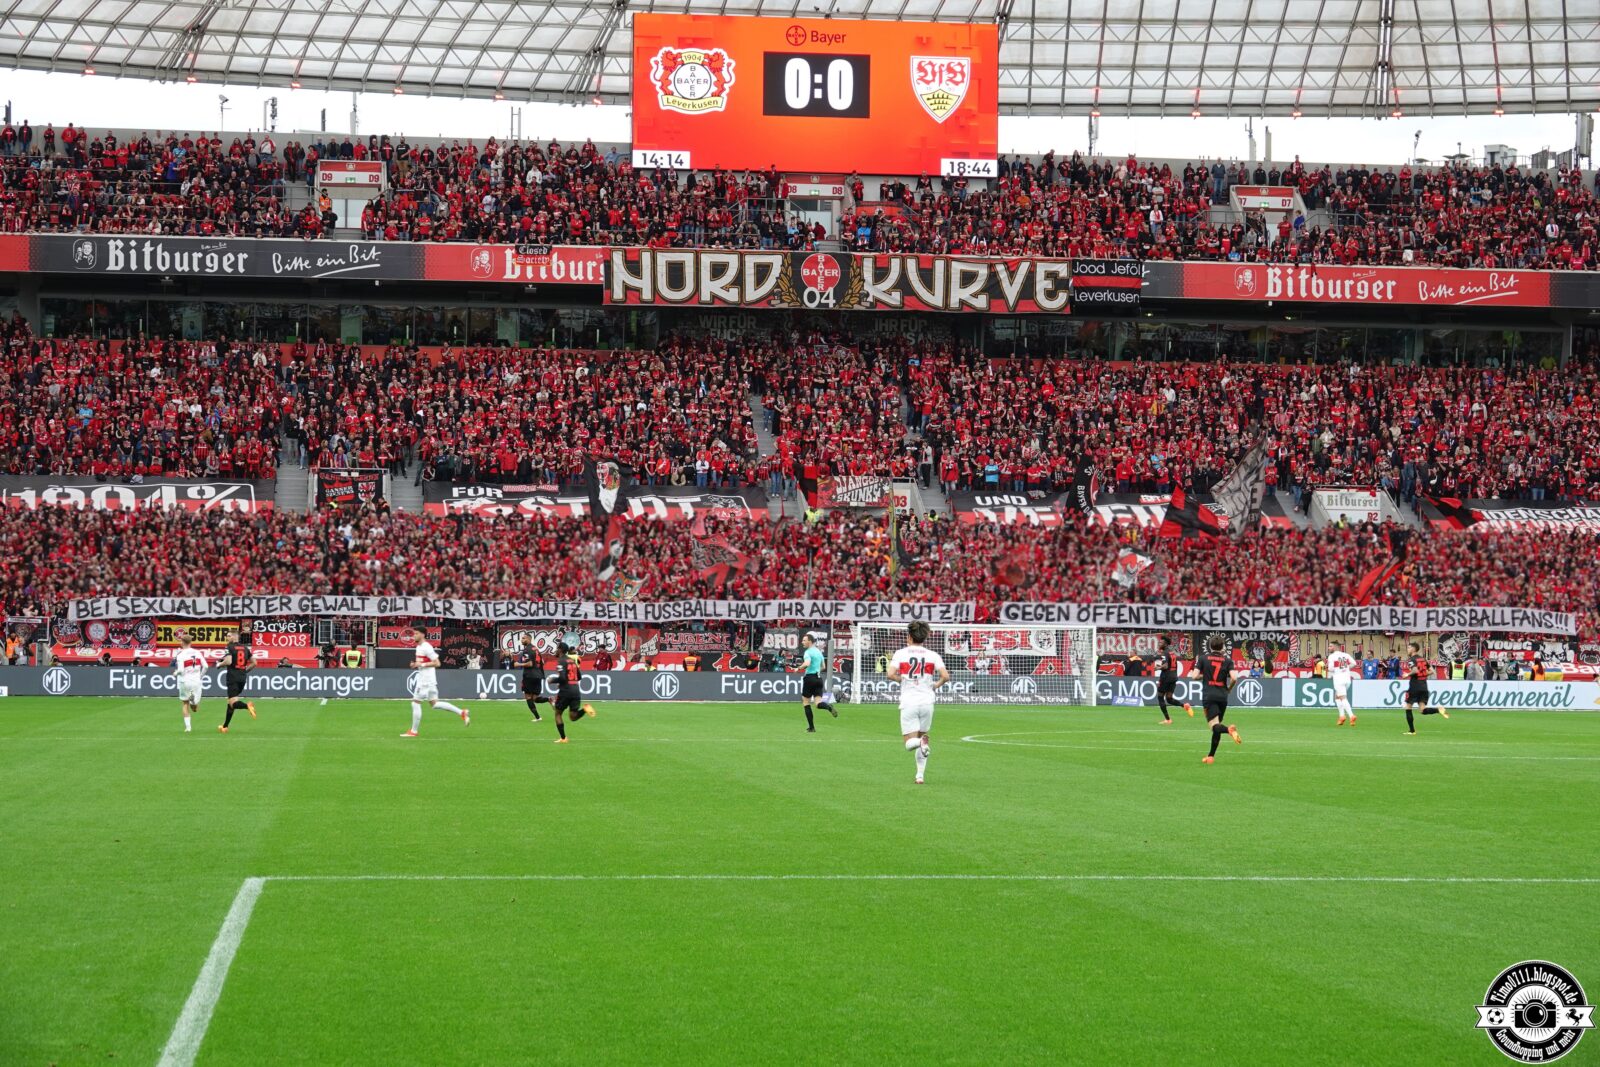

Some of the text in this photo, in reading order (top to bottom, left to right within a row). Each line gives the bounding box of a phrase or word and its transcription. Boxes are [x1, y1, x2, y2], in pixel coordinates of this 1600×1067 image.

[811, 30, 846, 46] Bayer
[683, 54, 702, 62] 1904
[917, 60, 966, 86] VfB
[785, 57, 853, 110] 0:0
[666, 97, 718, 110] Leverkusen
[642, 153, 684, 166] 14:14
[950, 161, 991, 174] 18:44
[322, 173, 333, 181] D9
[369, 174, 379, 182] D9
[832, 186, 842, 195] D8
[106, 239, 248, 273] Bitburger
[518, 245, 549, 255] Closed
[272, 252, 311, 273] Bitte
[316, 253, 345, 267] ein
[516, 256, 549, 265] Society
[1072, 261, 1105, 275] Jood
[803, 268, 838, 277] BAYER
[817, 254, 825, 290] BAYER
[611, 250, 1070, 311] NORD KURVE
[1265, 267, 1397, 300] Bitburger
[1419, 272, 1520, 300] Bitte ein Bit
[803, 288, 837, 308] 04
[1074, 288, 1140, 303] Leverkusen
[700, 313, 756, 328] WIR FÜR
[875, 319, 897, 331] IHR
[452, 486, 503, 498] FÜR
[975, 495, 1028, 505] UND
[1327, 494, 1379, 508] Bitburger
[76, 599, 109, 619] BEI
[115, 596, 291, 616] SEXUALISIERTER
[298, 596, 368, 614] GEWALT
[377, 596, 412, 614] GILT
[422, 598, 455, 615] DER
[594, 602, 638, 620] BEIM
[645, 601, 723, 620] FUSSBALL
[728, 602, 771, 619] HAUT
[778, 601, 804, 618] IHR
[810, 602, 846, 618] AUF
[855, 602, 893, 619] DEN
[900, 602, 970, 621] PUTZ!!!
[1005, 603, 1569, 632] GEGEN ÖFFENTLICHKEITSFAHNDUNGEN BEI FUSSBALLFANS!!!
[254, 619, 304, 633] Bayer
[255, 633, 306, 647] Lions
[380, 631, 399, 640] LEV
[1233, 631, 1257, 641] MAD
[1260, 632, 1289, 644] BOYZ
[1486, 640, 1532, 650] YOUNG
[908, 656, 925, 679] 21
[1211, 661, 1222, 681] 7
[45, 669, 69, 692] MG
[109, 669, 146, 690] Für
[476, 674, 516, 694] MG
[653, 673, 678, 697] MG
[721, 674, 756, 694] Für
[760, 675, 804, 695] echt
[1119, 681, 1203, 700] MOOR
[1239, 681, 1261, 704] MG
